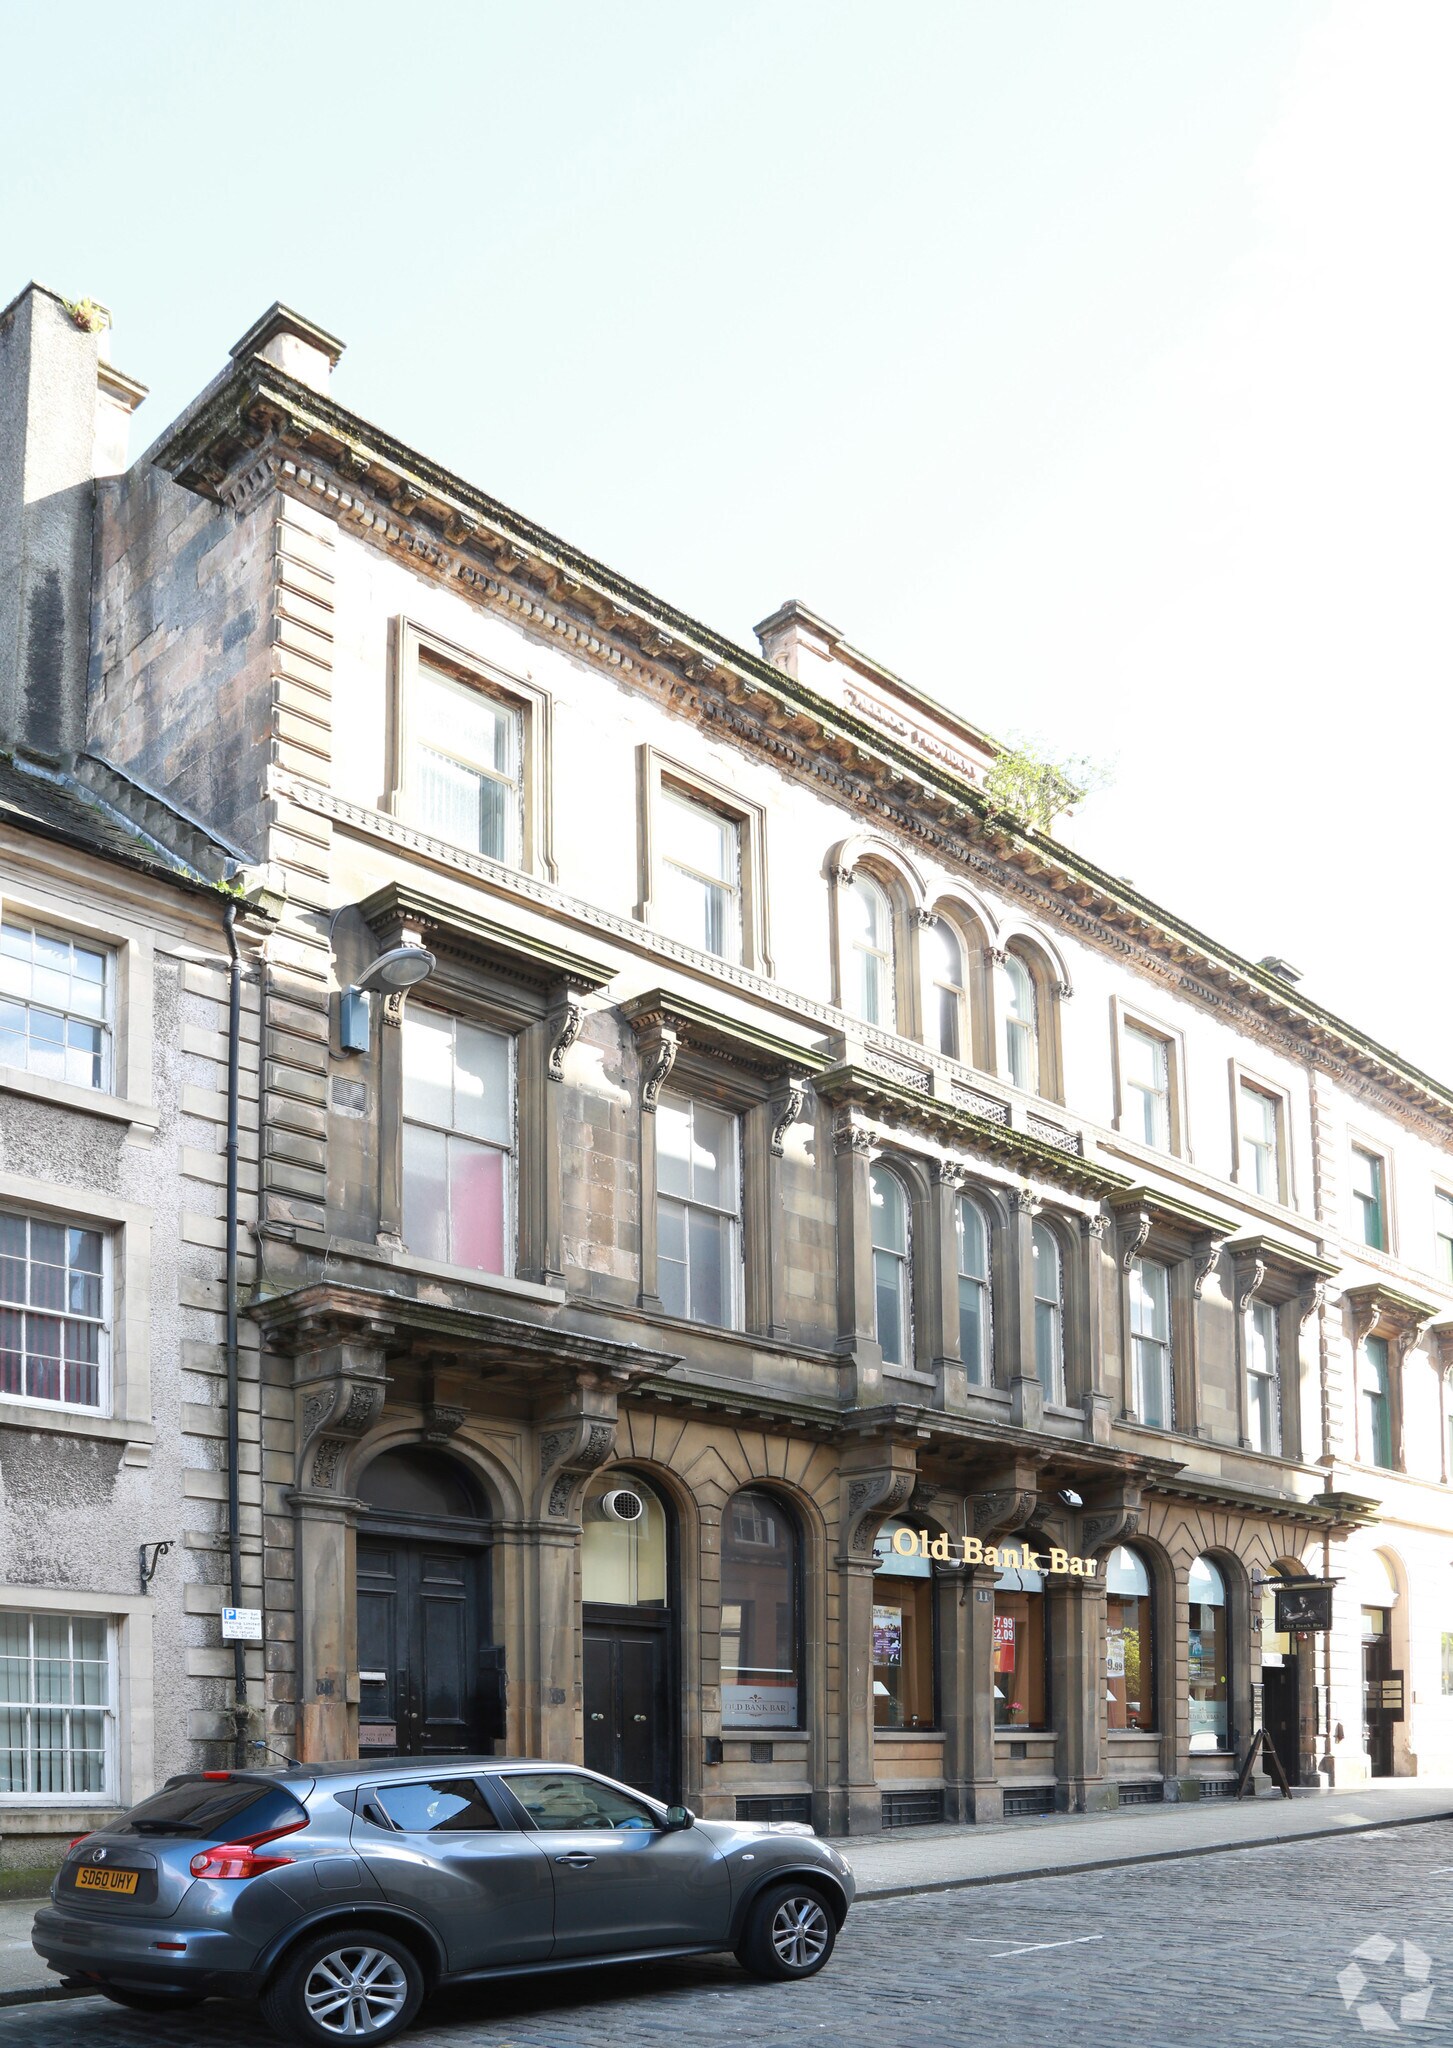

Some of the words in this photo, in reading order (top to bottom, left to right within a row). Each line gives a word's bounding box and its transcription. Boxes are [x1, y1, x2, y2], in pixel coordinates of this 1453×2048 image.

[893, 1528, 950, 1560] Old
[961, 1536, 1041, 1571] Bank
[1049, 1547, 1098, 1577] Bar
[978, 1591, 989, 1602] 11
[226, 1609, 235, 1619] P
[725, 1703, 743, 1711] OLD
[745, 1703, 768, 1711] BANK
[770, 1704, 786, 1712] BAR
[81, 1869, 110, 1886] SD60
[110, 1872, 134, 1890] UHY
